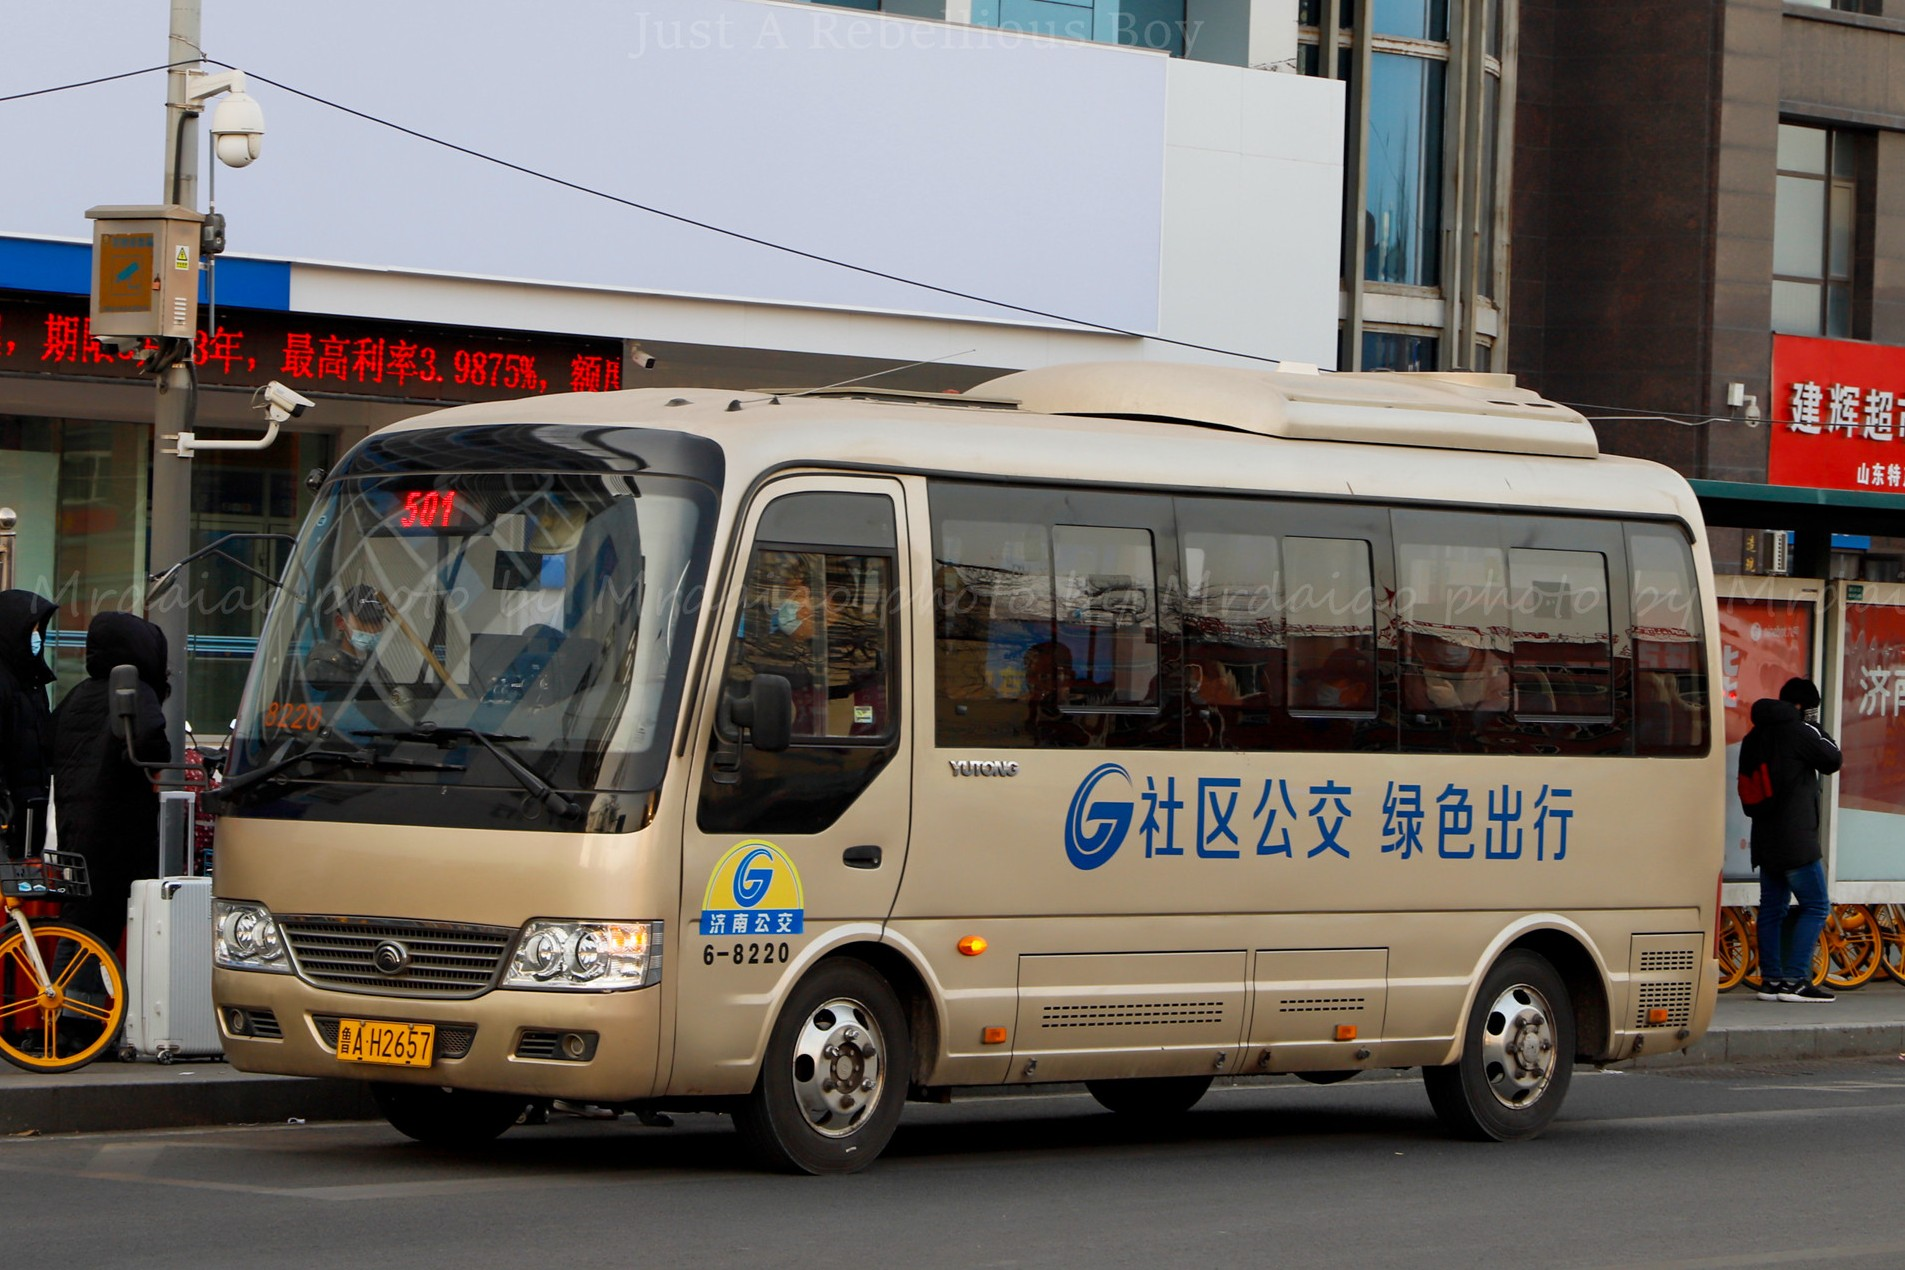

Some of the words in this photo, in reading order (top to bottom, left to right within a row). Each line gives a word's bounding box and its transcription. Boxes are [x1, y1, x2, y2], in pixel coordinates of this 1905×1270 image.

[1790, 381, 1905, 441] 建辉超
[1857, 462, 1905, 488] 山东特
[401, 490, 456, 528] 501
[265, 702, 323, 731] 8220
[949, 760, 1020, 777] YUTONG
[1139, 776, 1352, 859] 社区公交
[1380, 781, 1574, 861] 绿色出行
[709, 912, 793, 934] 济南公交
[703, 942, 789, 965] 6-8220
